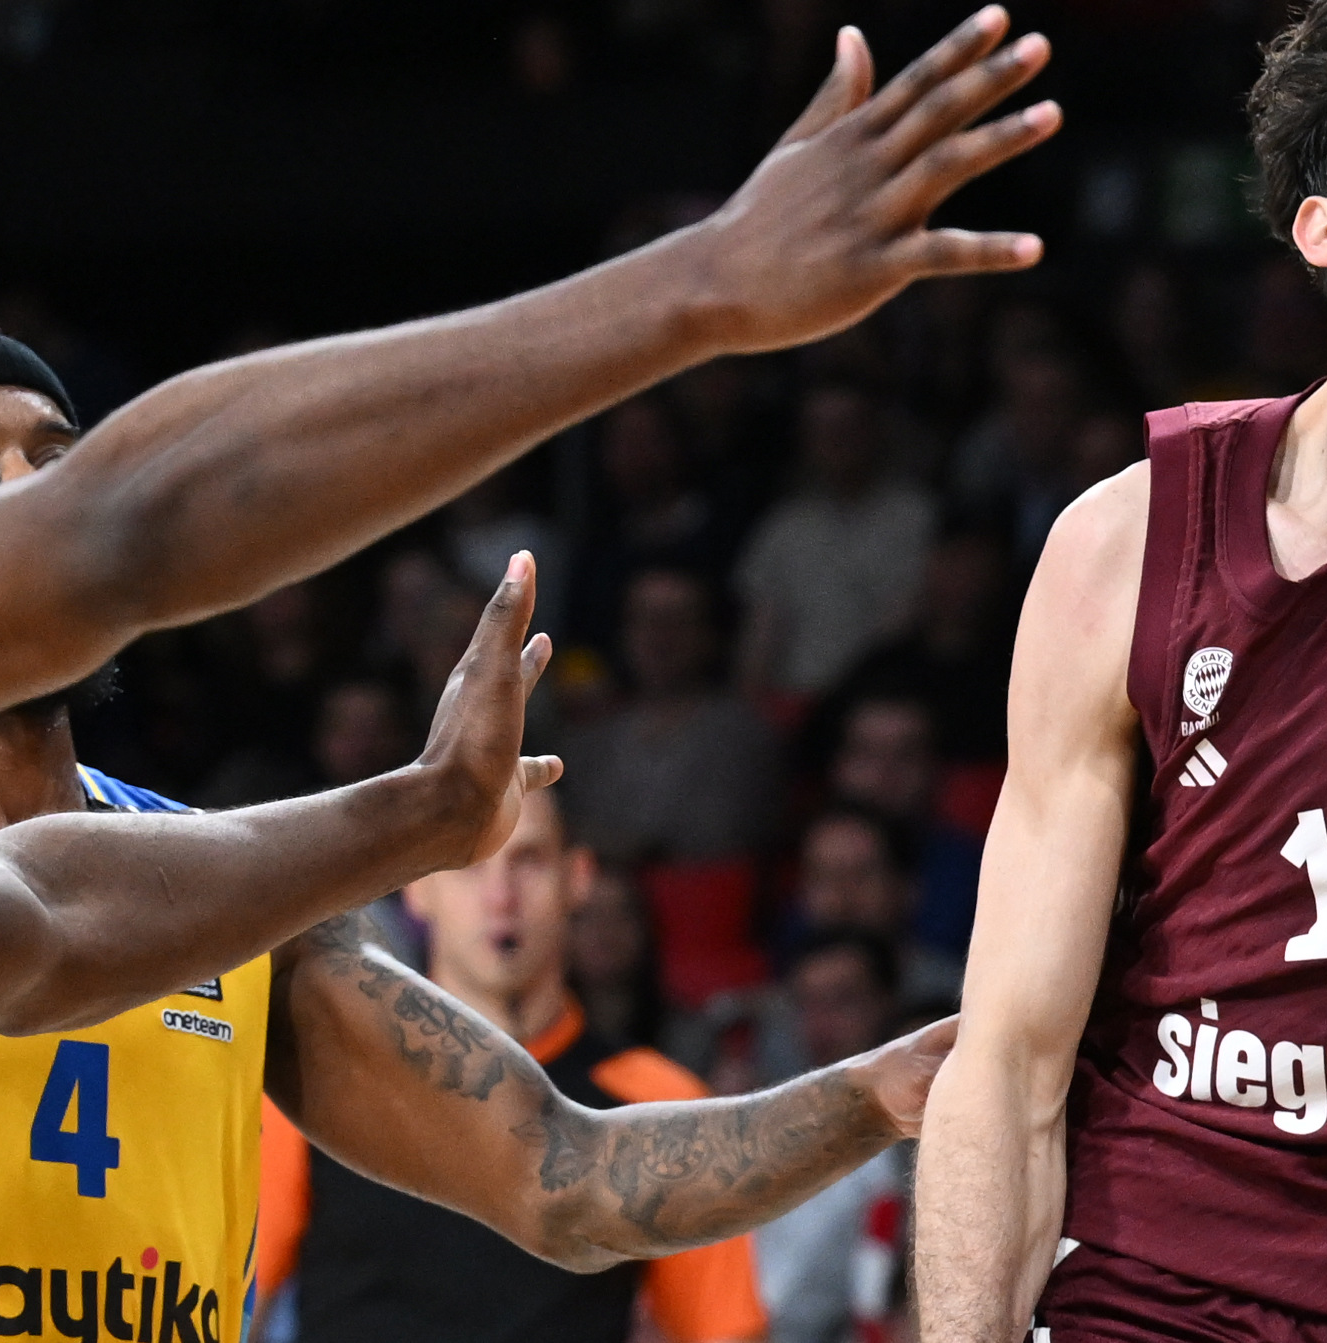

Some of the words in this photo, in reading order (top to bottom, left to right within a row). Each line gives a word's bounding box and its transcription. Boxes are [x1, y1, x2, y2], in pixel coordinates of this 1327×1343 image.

[1187, 662, 1199, 677] FC
[163, 1010, 233, 1041] oneteam
[29, 1039, 120, 1199] 4
